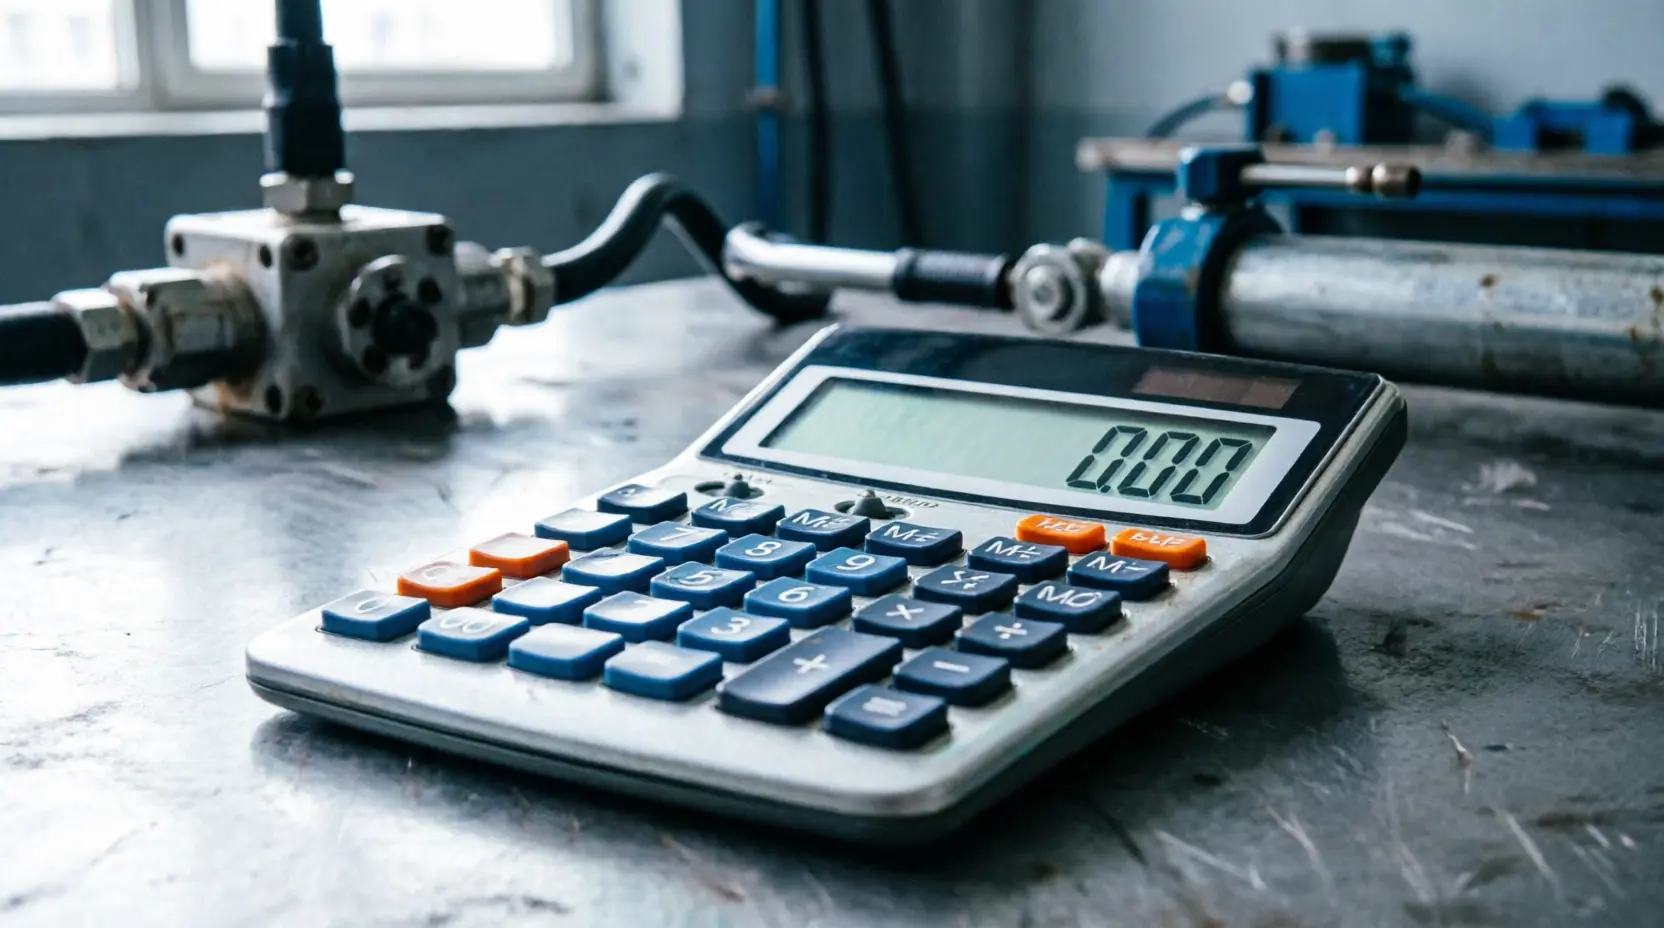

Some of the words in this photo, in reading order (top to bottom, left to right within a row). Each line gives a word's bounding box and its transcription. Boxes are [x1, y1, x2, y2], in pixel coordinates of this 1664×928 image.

[1066, 425, 1253, 505] 0.00
[659, 527, 695, 541] 7
[744, 541, 782, 557] 8
[836, 554, 876, 571] 9
[678, 570, 714, 586] 5
[777, 586, 816, 602] 6
[711, 617, 751, 634] 3
